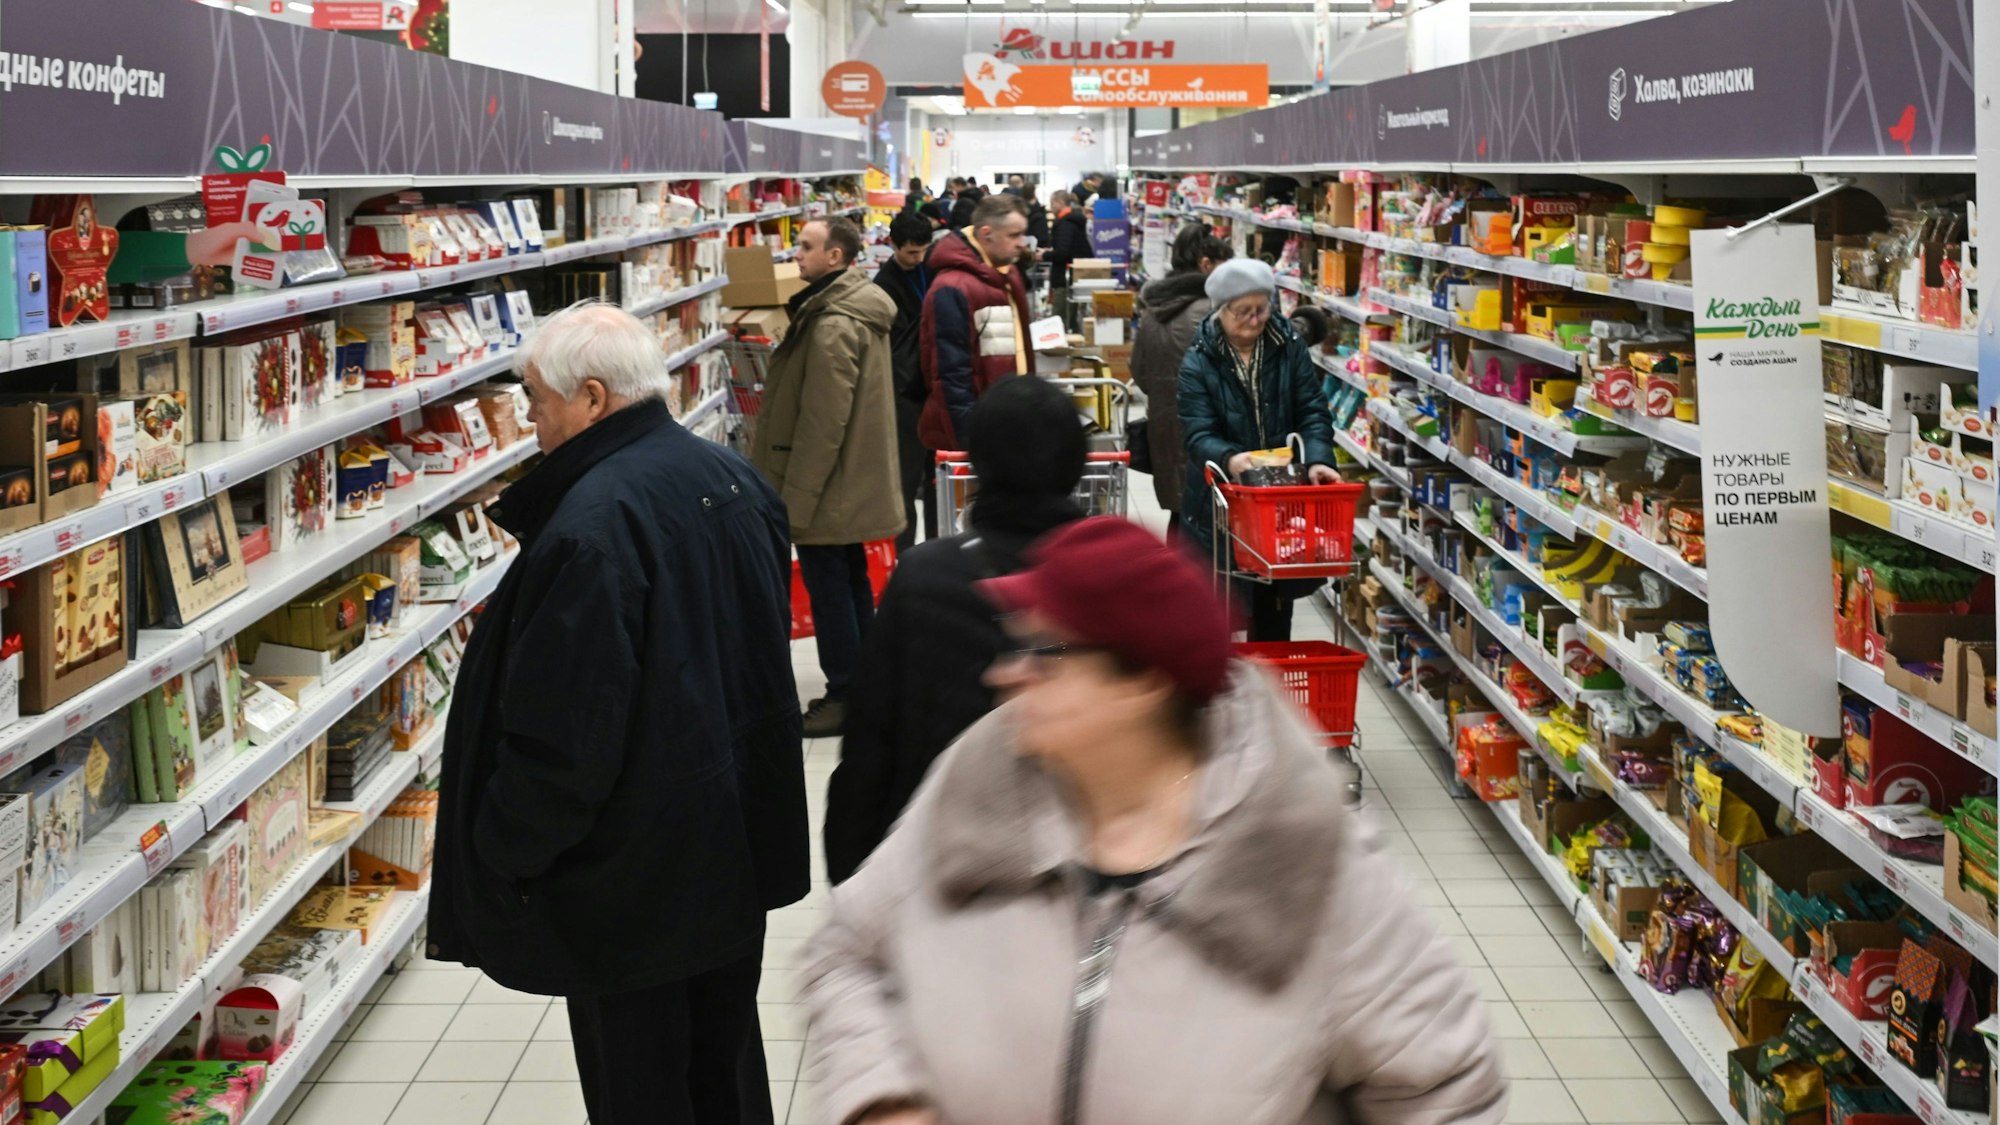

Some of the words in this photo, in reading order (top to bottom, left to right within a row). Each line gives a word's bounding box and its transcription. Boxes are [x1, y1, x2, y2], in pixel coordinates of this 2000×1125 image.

[67, 54, 166, 106] конфеты
[1633, 74, 1682, 104] Халва,
[1681, 66, 1755, 98] козинаки
[1533, 201, 1578, 215] BEBETO
[1706, 297, 1801, 319] Каждый
[1744, 319, 1799, 338] День
[1729, 350, 1755, 358] НАША
[1756, 349, 1785, 357] МАРКА
[1730, 357, 1771, 366] СОЗДАНО
[1773, 357, 1798, 365] АШАН
[425, 461, 445, 470] erci
[1713, 452, 1791, 468] НУЖНЫЕ
[1714, 471, 1785, 487] ТОВАРЫ
[1715, 493, 1739, 506] ПО
[1745, 490, 1817, 505] ПЕРВЫМ
[1716, 511, 1779, 527] ЦЕНАМ
